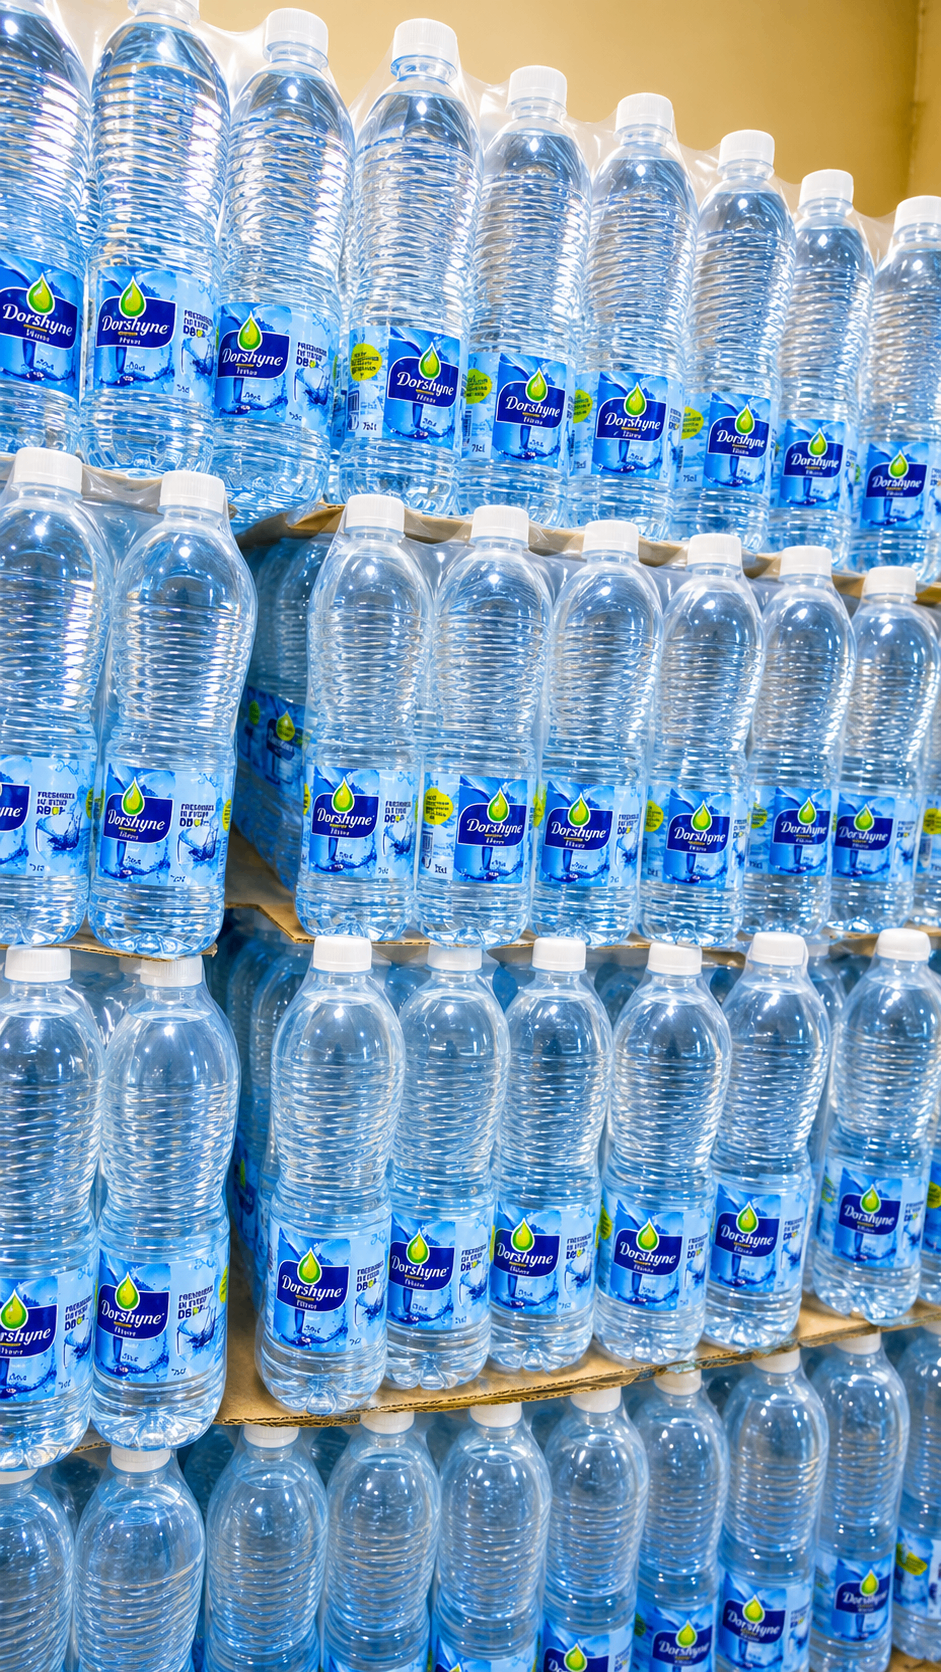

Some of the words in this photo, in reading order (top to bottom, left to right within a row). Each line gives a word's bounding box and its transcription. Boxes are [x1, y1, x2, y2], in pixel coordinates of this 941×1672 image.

[2, 303, 73, 337] Dorshyne
[102, 315, 169, 336] Dorshyne
[222, 347, 284, 368] Dorshyne
[397, 371, 454, 396] Dorshyne
[506, 396, 560, 419] Dorshyne
[605, 412, 661, 431] Dorshyne
[716, 430, 765, 449] Dorshyne
[791, 453, 839, 470] Dorshyne
[108, 809, 165, 832] Dorshyne
[317, 808, 372, 829] Dorshyne
[467, 819, 523, 837] Dorshyne
[781, 821, 828, 838] Dorshyne
[551, 821, 606, 842] Dorshyne
[838, 825, 889, 844] Dorshyne
[844, 1204, 895, 1228] Dorshyne
[721, 1224, 774, 1248] Dorshyne
[496, 1242, 554, 1268] Dorshyne
[619, 1242, 676, 1267] Dorshyne
[391, 1255, 447, 1281] Dorshyne
[282, 1275, 342, 1302] Dorshyne
[101, 1299, 162, 1328] Dorshyne
[0, 1328, 51, 1346] rshyne
